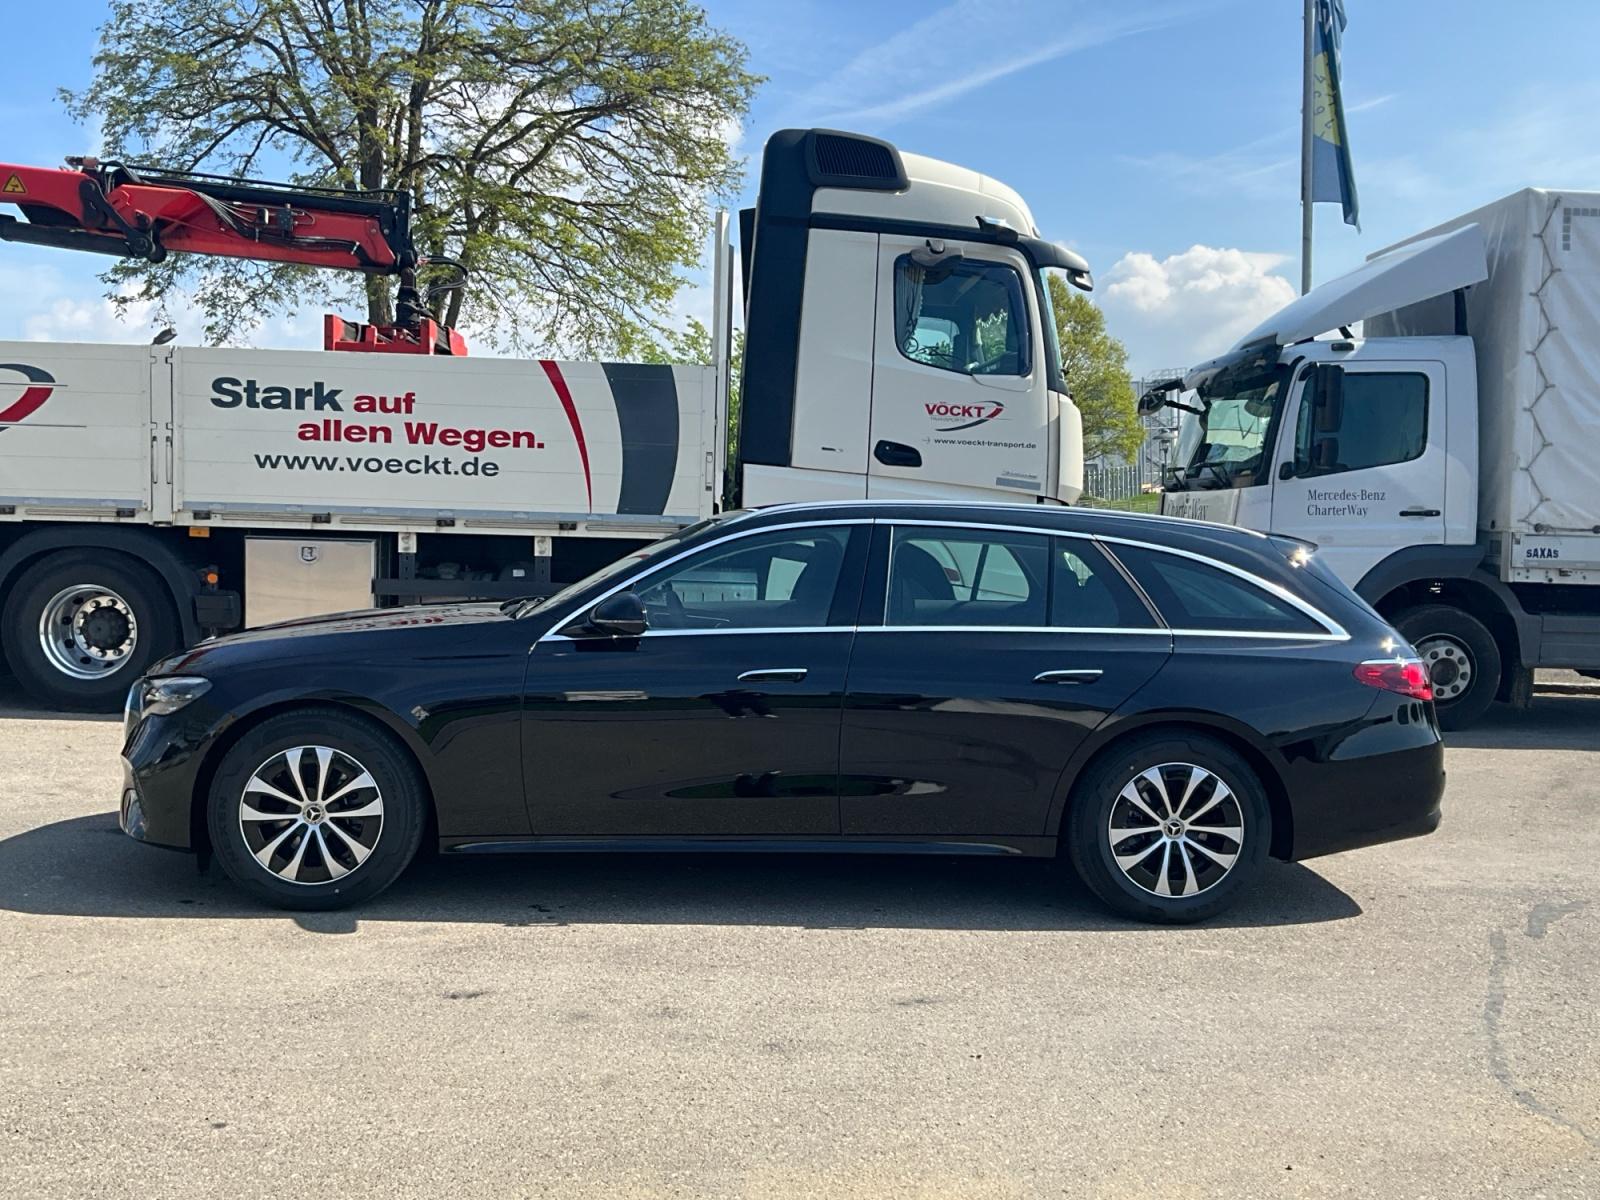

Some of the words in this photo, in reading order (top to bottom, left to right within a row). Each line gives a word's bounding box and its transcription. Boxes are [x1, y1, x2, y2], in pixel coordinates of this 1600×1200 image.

[210, 376, 344, 412] Stark
[353, 392, 416, 414] auf
[924, 401, 985, 417] VÖCKT
[297, 419, 392, 443] allen
[404, 422, 545, 452] Wegen.
[934, 438, 1037, 449] www.voeckt-transport.de
[254, 453, 500, 477] www.voeckt.de
[1307, 489, 1386, 501] Mercedes-Benz
[1307, 504, 1368, 517] CharterWay
